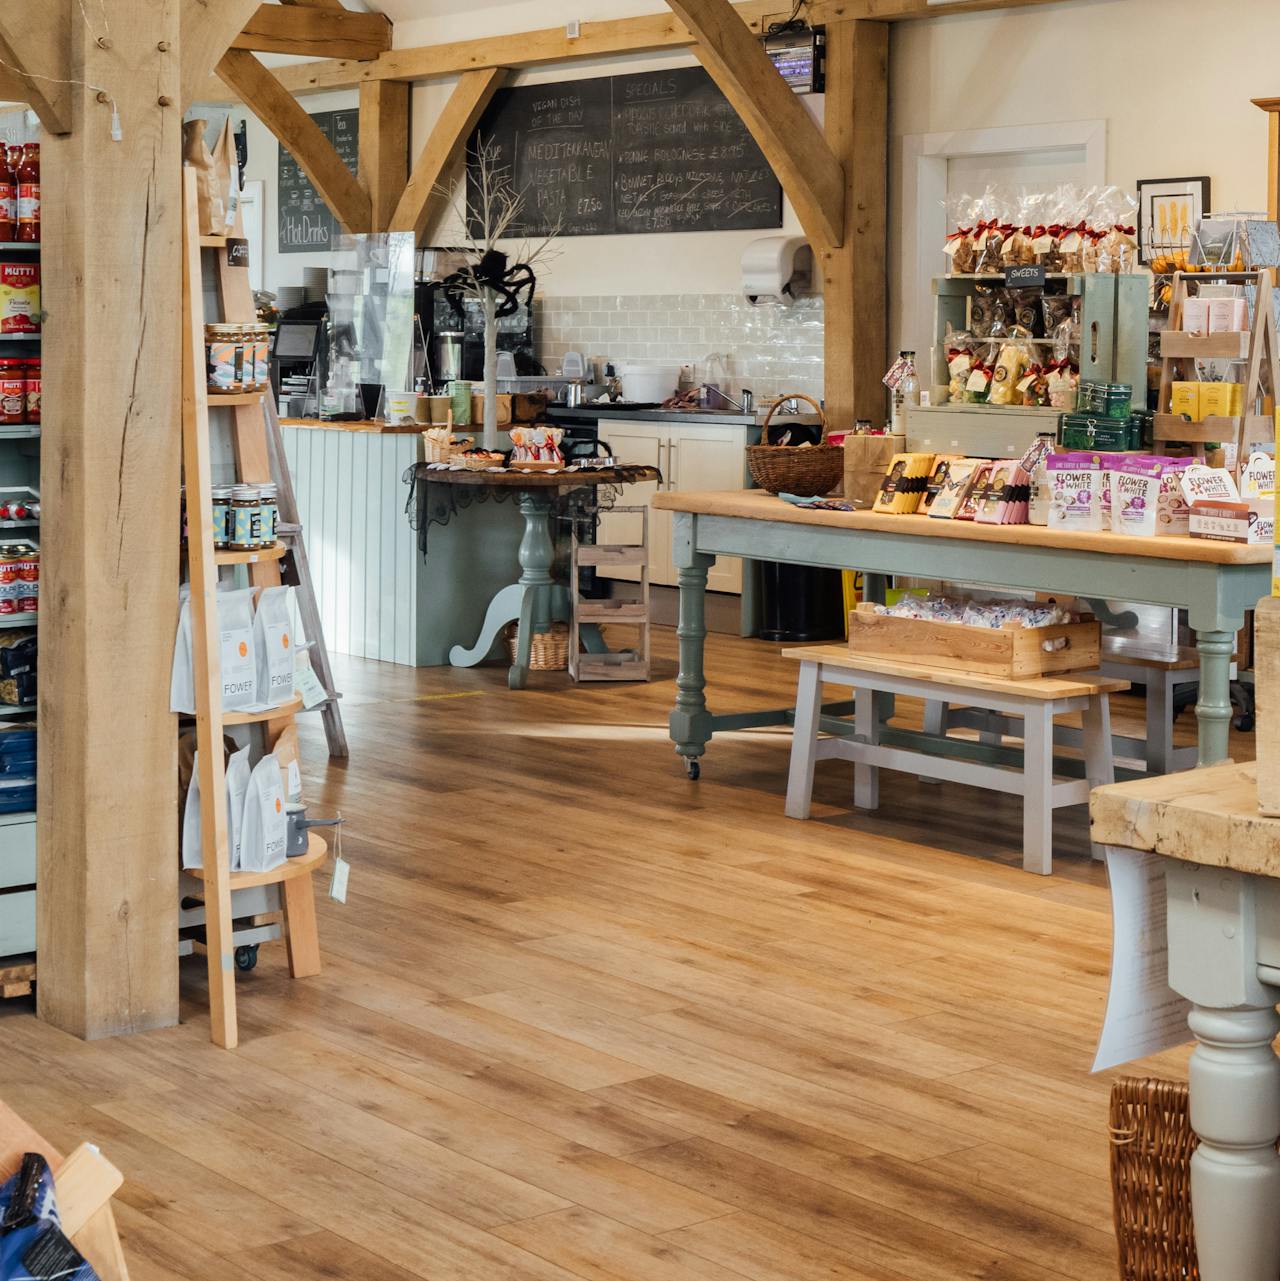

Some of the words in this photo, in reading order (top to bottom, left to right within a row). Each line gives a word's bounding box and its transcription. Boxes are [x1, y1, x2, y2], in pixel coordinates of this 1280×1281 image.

[537, 188, 568, 209] PASTA
[287, 216, 302, 244] Hot
[302, 215, 329, 243] Drinks
[5, 267, 34, 276] MUTTI
[1010, 268, 1039, 278] SWEETS
[1056, 472, 1092, 483] FLOWER
[1119, 475, 1149, 489] FLOWER
[1189, 476, 1224, 487] FLOWER
[1066, 481, 1092, 490] WHITE
[1203, 484, 1227, 493] WHITE
[1124, 486, 1147, 496] WHITE
